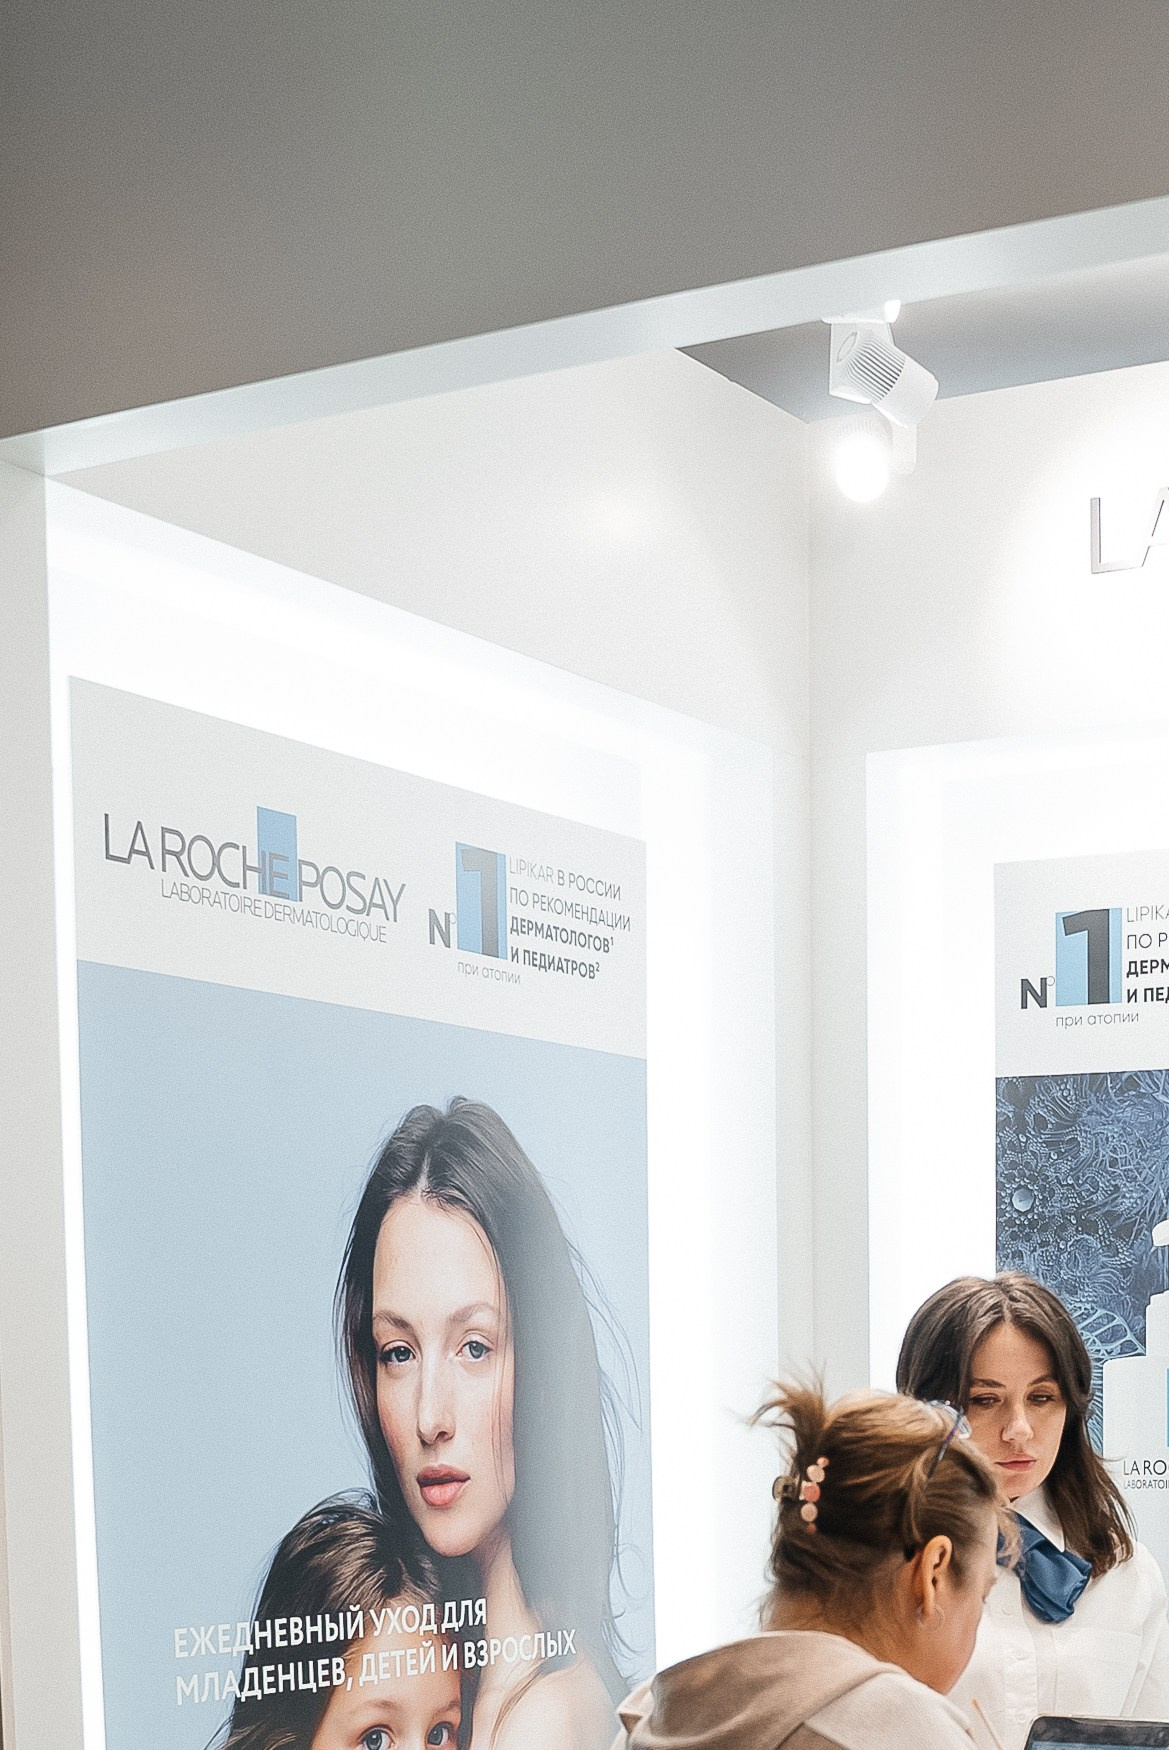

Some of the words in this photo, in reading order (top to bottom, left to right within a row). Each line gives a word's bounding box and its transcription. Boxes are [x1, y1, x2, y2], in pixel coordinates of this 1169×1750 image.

[104, 812, 155, 871] LA
[160, 826, 290, 900] ROCHE
[298, 858, 406, 923] POSAY
[509, 855, 554, 883] LIPIKAR
[557, 867, 566, 885] В
[568, 869, 621, 902] РОССИИ
[161, 878, 262, 919] LABORATOIRE
[263, 900, 387, 944] DERMATOLOGIQUE
[510, 886, 529, 908] ПО
[532, 891, 631, 933] РЕКОМЕНДАЦИИ
[510, 945, 519, 964] И
[1126, 932, 1153, 950] ПО
[457, 960, 480, 979] при
[482, 964, 521, 985] атопии
[1126, 988, 1138, 1004] И
[1055, 1012, 1083, 1029] при
[1087, 1011, 1140, 1027] атопии
[173, 1605, 365, 1659] ЕЖЕДНЕВНЫЙ
[369, 1601, 439, 1639] УХОД
[441, 1597, 487, 1634] ДЛЯ
[175, 1657, 353, 1706] МЛАДЕНЦЕВ,
[358, 1640, 436, 1686] ДЕТЕЙ
[440, 1643, 459, 1673] И
[464, 1628, 577, 1671] ВЗРОСЛЫХ
